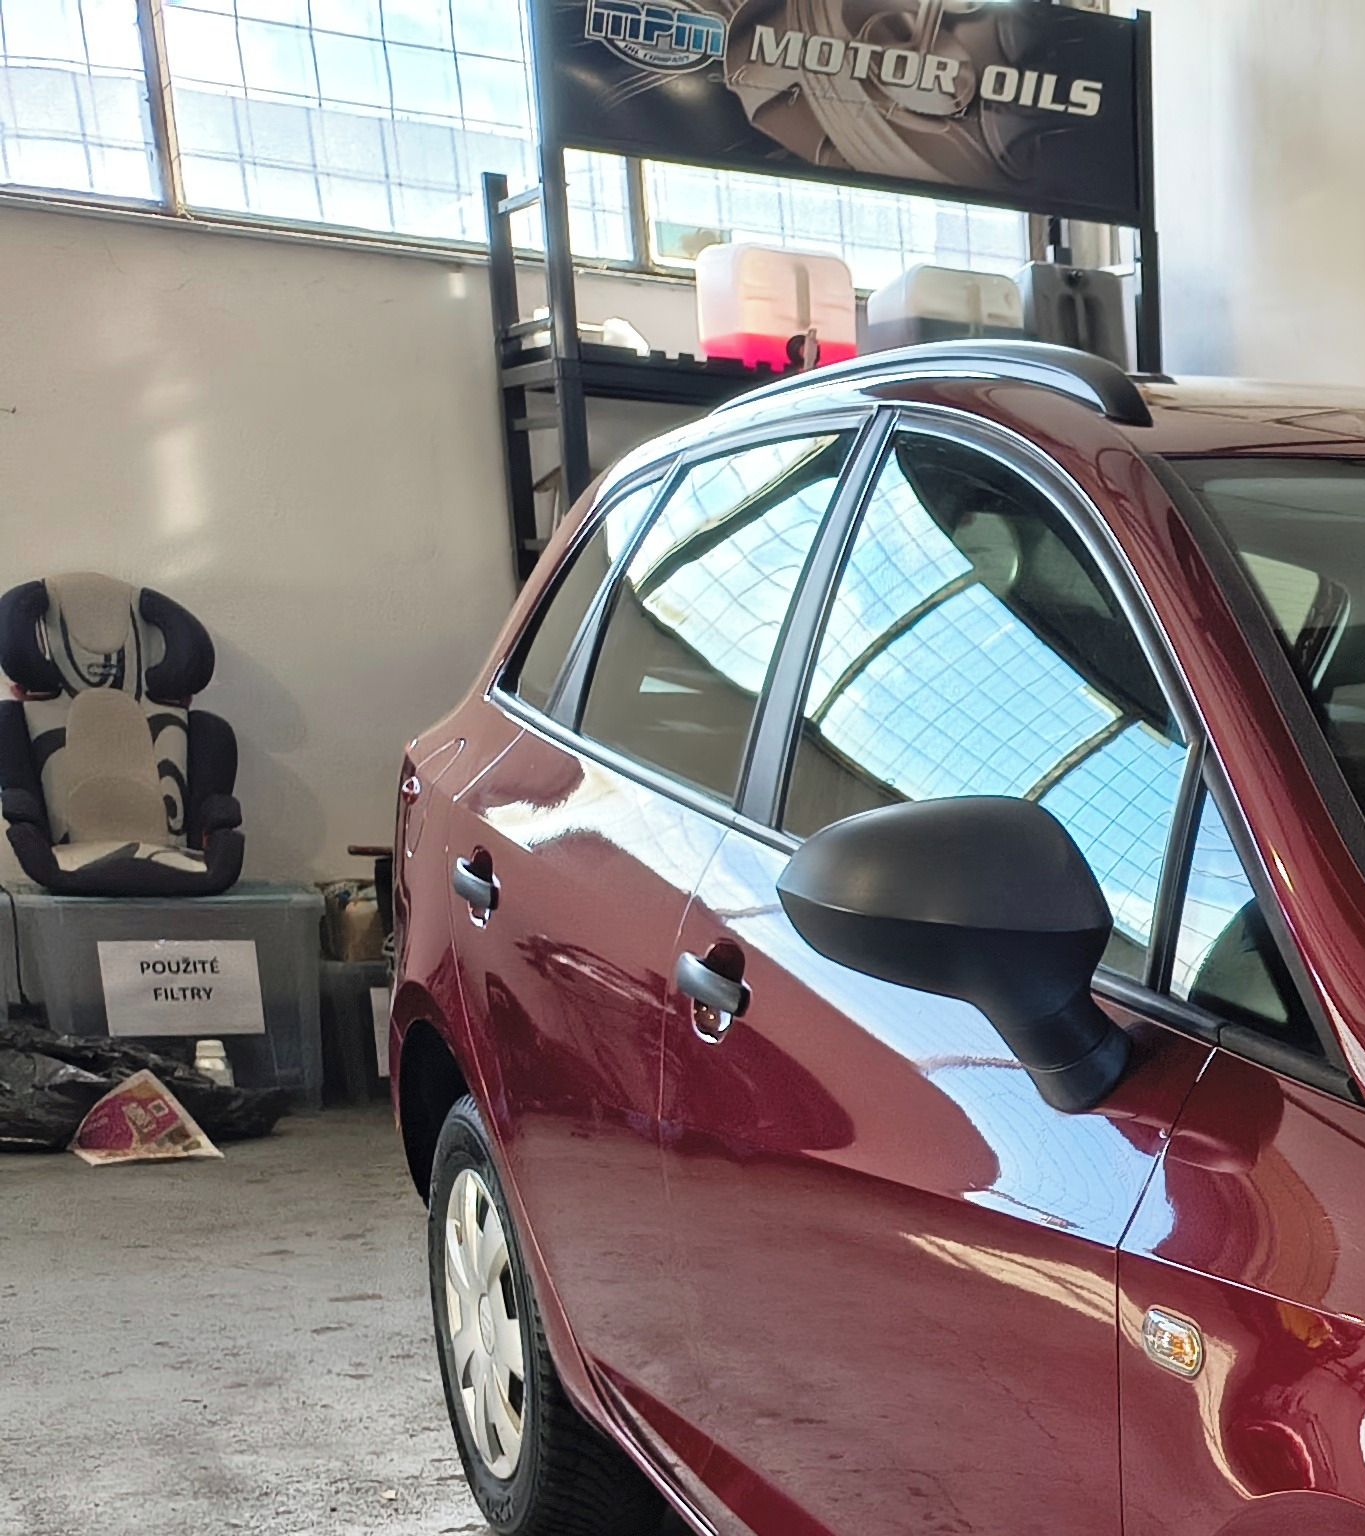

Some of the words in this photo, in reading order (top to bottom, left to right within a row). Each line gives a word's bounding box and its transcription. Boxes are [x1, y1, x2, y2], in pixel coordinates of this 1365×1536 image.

[750, 25, 959, 95] MOTOR
[980, 64, 1104, 118] OILS
[139, 956, 221, 976] POUŽITÉ
[152, 986, 215, 1002] FILTRY
